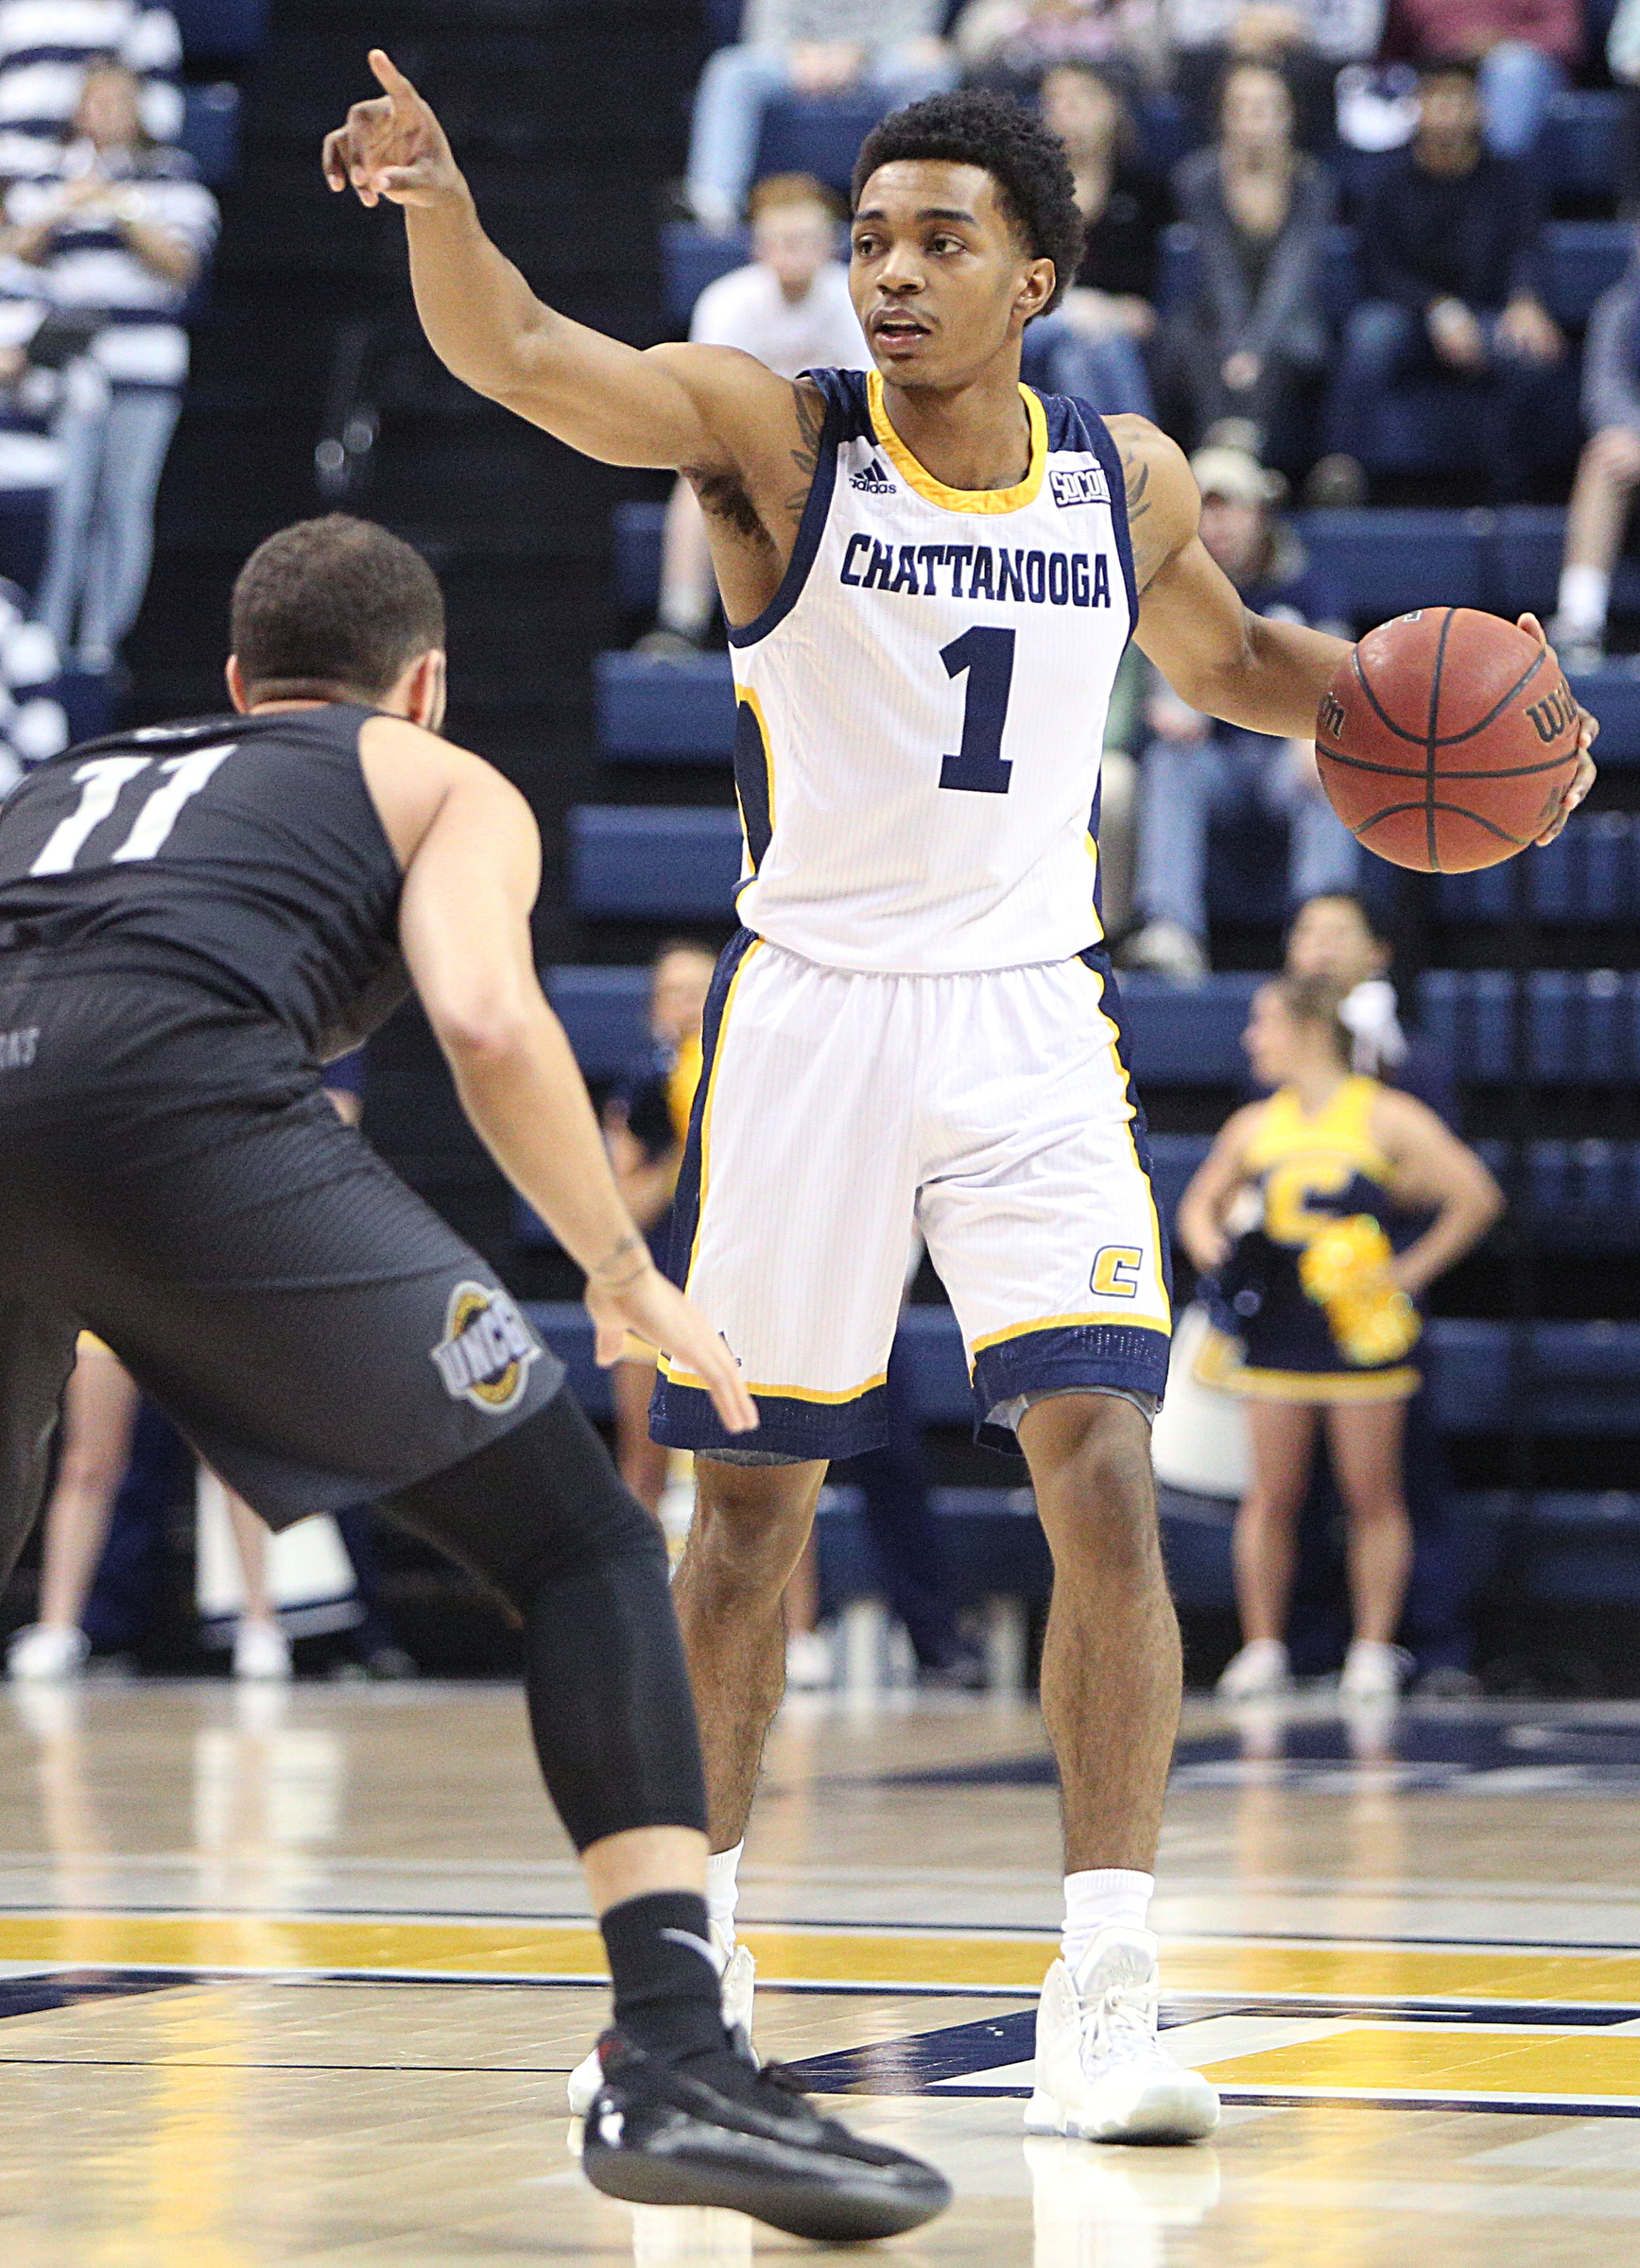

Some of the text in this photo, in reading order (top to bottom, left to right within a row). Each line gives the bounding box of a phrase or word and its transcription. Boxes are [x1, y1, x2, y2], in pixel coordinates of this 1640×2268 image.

[839, 532, 1112, 609] CHATTANOOGA
[939, 626, 1016, 794] 1
[29, 744, 238, 877] 11
[1089, 1245, 1143, 1298] C
